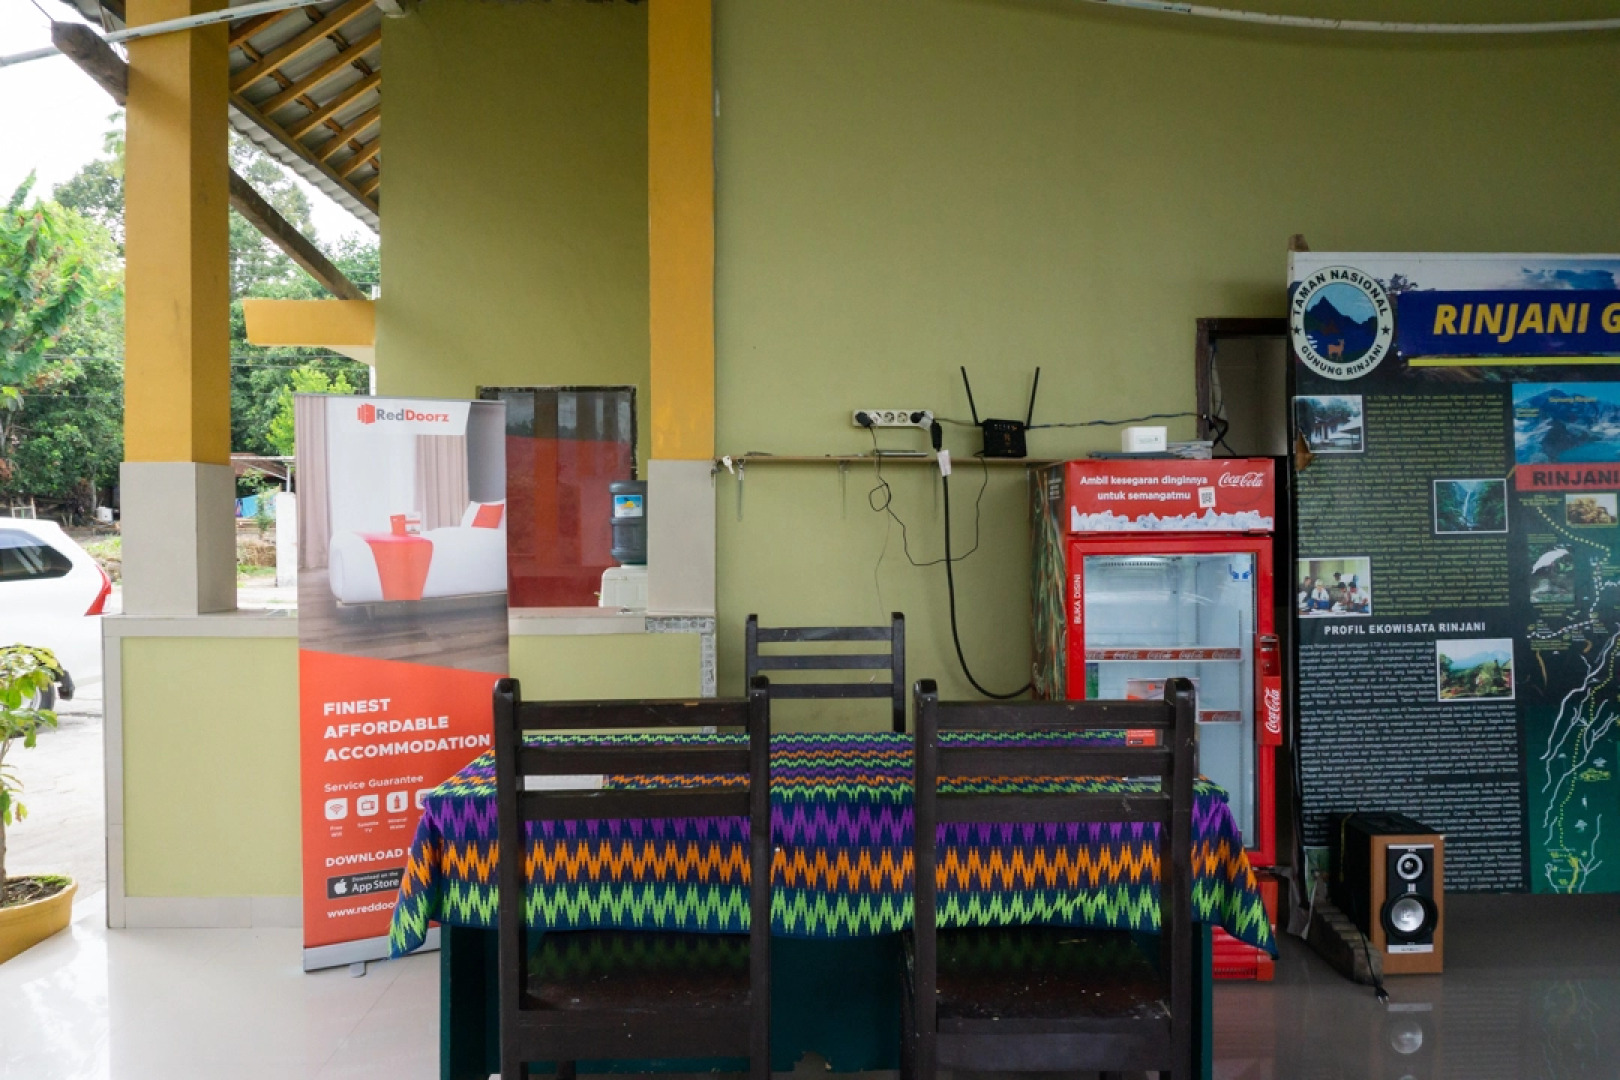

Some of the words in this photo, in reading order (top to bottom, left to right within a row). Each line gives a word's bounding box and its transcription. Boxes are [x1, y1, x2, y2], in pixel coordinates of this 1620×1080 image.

[1293, 271, 1326, 317] TAMAN
[1330, 269, 1389, 317] NASIONAL
[1433, 303, 1591, 343] RINJANI
[1301, 344, 1343, 376] GUNUNG
[1346, 344, 1383, 376] RINJANI
[376, 408, 449, 422] RedDoorz
[1080, 475, 1108, 485] Ambil
[1110, 475, 1159, 486] kesegaran
[1161, 475, 1208, 486] dinginnya
[1533, 470, 1620, 486] RINJANI
[1097, 491, 1126, 500] untuk
[1128, 491, 1191, 501] semangatmu
[1324, 625, 1366, 635] PROFIL
[1368, 622, 1436, 634] EKOWISATA
[1438, 621, 1486, 632] RINJANI
[324, 698, 391, 715] FINEST
[324, 716, 449, 738] AFFORDABLE
[324, 734, 491, 763] ACCOMMODATION
[324, 781, 366, 793] Service
[368, 774, 424, 788] Guarantee
[325, 848, 404, 868] DOWNLOAD
[351, 882, 373, 893] App
[374, 877, 400, 890] Store
[352, 873, 380, 882] Download
